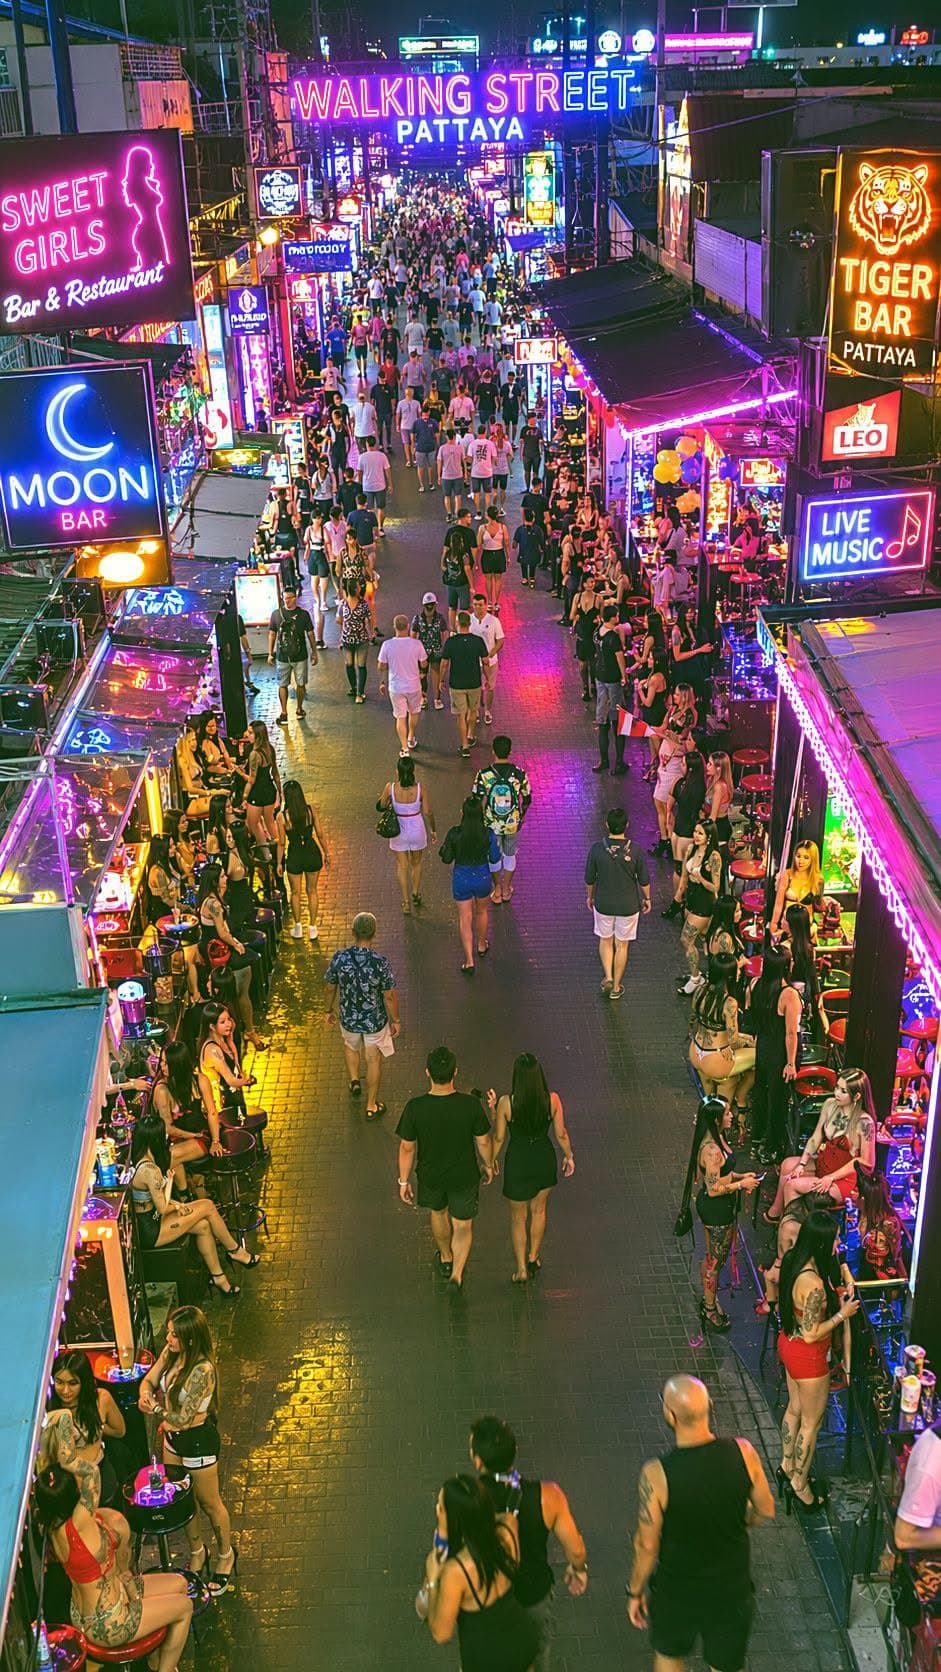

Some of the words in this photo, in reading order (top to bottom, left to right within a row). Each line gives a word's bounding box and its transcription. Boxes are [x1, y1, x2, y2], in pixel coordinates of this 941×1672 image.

[294, 75, 472, 120] WALKING
[486, 70, 635, 113] STREET
[396, 117, 524, 143] PATTAYA
[1, 171, 108, 231] SWEET
[15, 219, 106, 274] GIRLS
[3, 294, 41, 323] Bar
[45, 286, 61, 311] &
[65, 260, 165, 306] Restaurant
[840, 257, 933, 299] TIGER
[854, 300, 911, 336] BAR
[843, 340, 916, 367] PATTAYA
[839, 429, 882, 448] LEO
[9, 465, 149, 510] MOON
[61, 509, 107, 530] BAR
[822, 508, 872, 536] LIVE
[812, 537, 884, 566] MUSIC
